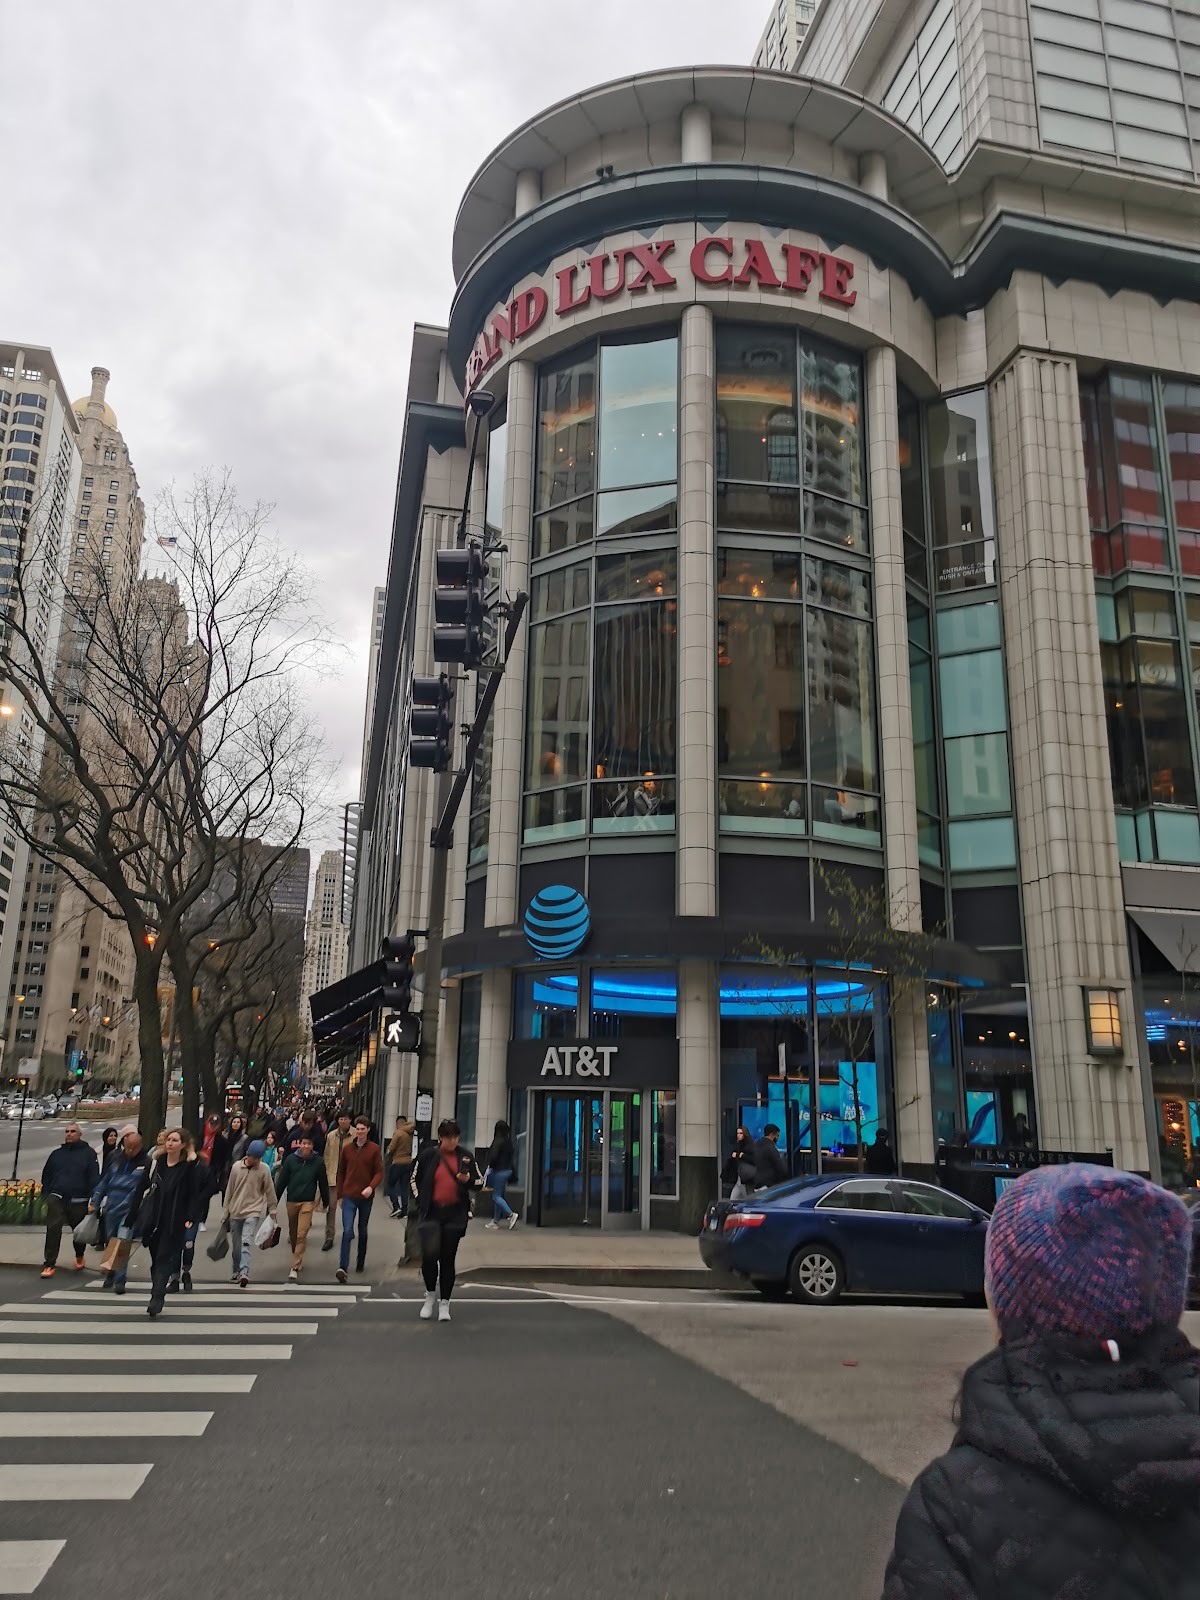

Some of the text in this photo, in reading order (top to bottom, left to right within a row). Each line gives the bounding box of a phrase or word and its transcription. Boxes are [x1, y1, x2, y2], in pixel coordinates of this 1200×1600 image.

[464, 237, 857, 402] RAND LUX CAFE
[942, 563, 975, 575] ENTRANCE
[963, 567, 988, 577] ONTARI
[540, 1045, 618, 1077] AT&T
[974, 1149, 1074, 1163] NEWSPAPERS
